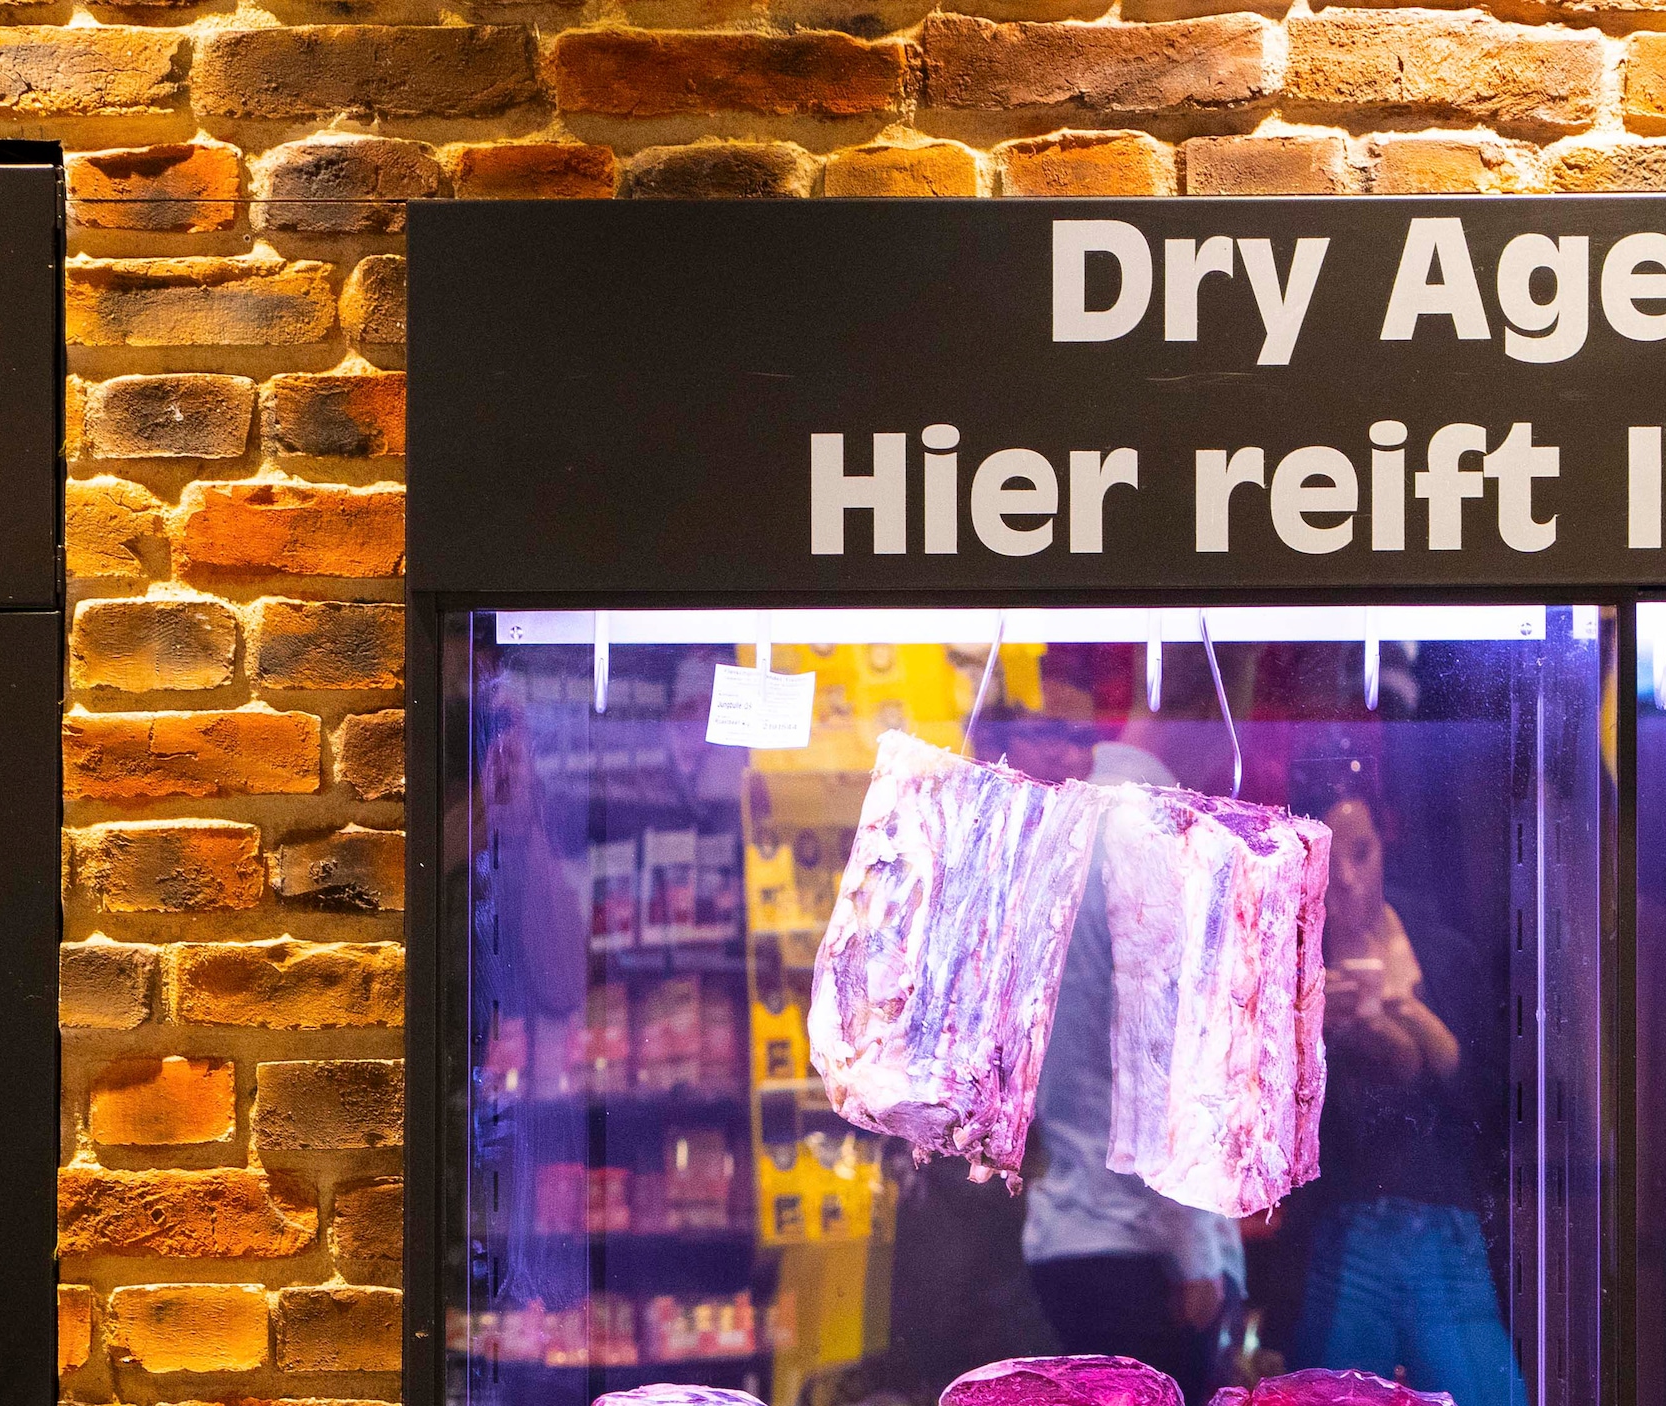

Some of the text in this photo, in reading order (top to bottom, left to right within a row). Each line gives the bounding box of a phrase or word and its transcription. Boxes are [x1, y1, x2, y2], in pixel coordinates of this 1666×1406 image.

[1051, 220, 1331, 366] Dry
[810, 424, 1139, 557] Hier
[1195, 420, 1560, 555] reift
